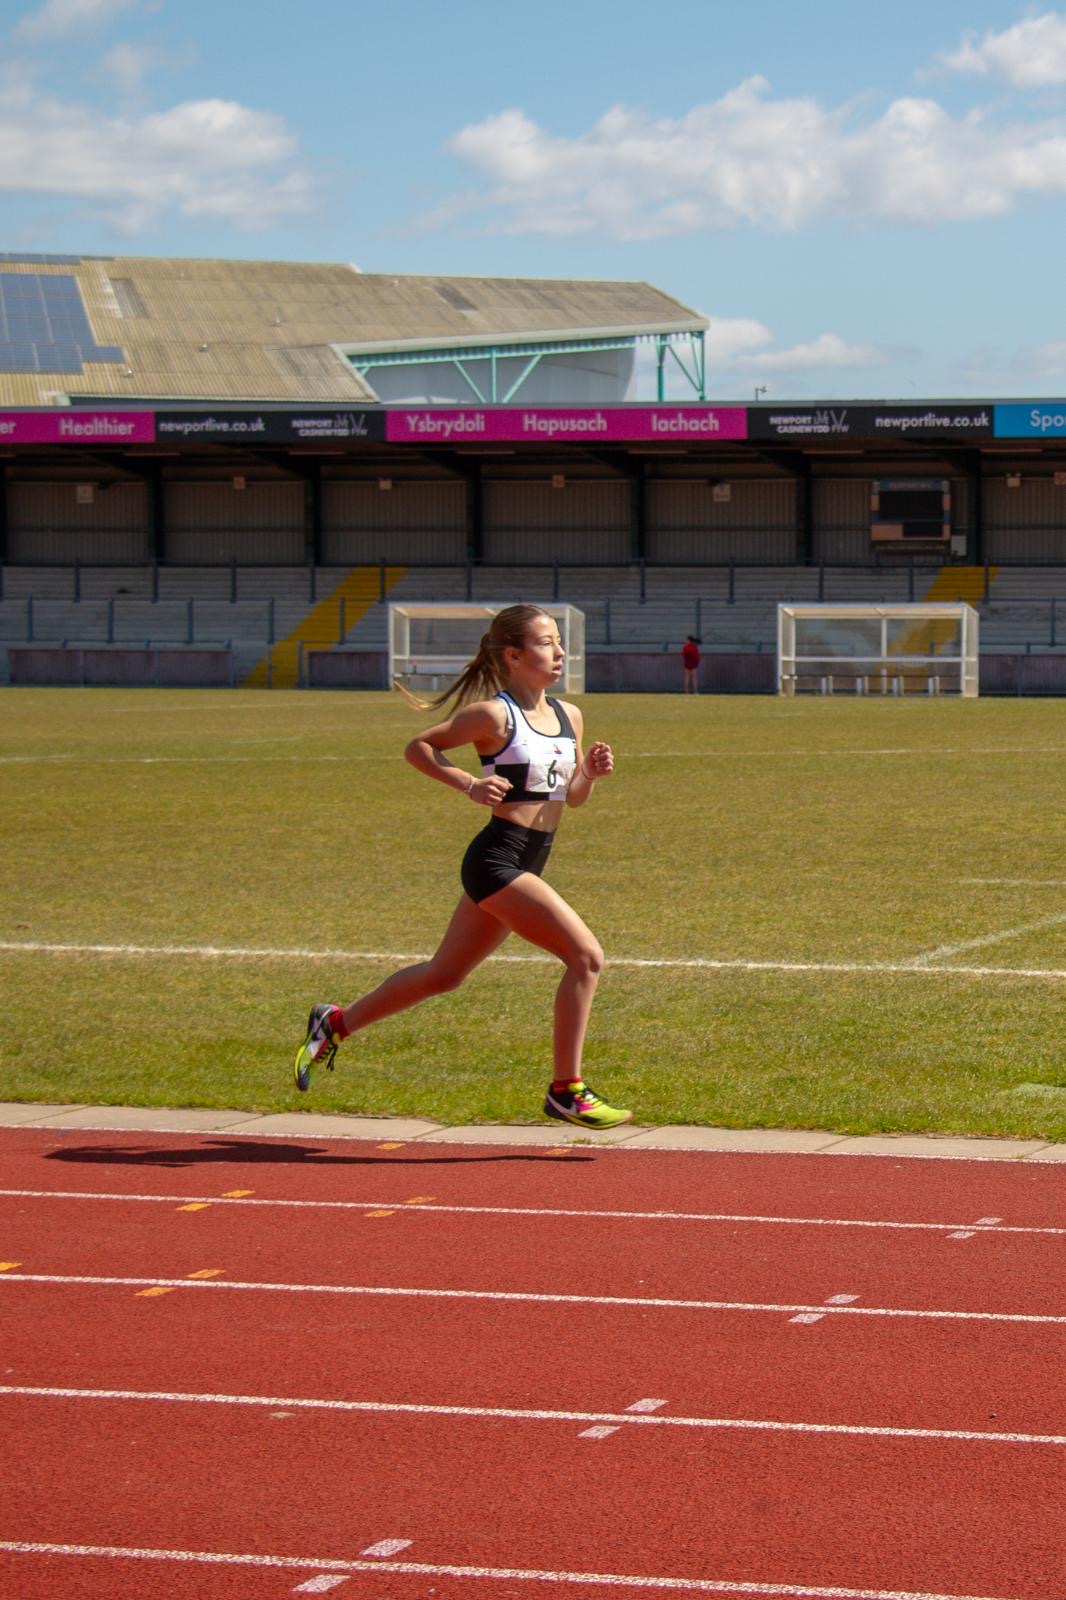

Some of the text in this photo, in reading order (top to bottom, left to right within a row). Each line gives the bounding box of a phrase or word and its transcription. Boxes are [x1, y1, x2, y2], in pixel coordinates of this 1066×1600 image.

[60, 417, 135, 436] Healthier
[159, 417, 266, 434] newportlive.co.uk
[407, 414, 485, 435] Ysbrydoli
[523, 414, 607, 433] Hapusach
[875, 412, 989, 430] newportlive.co.uk
[1030, 409, 1066, 432] Spo
[547, 760, 557, 788] 6
